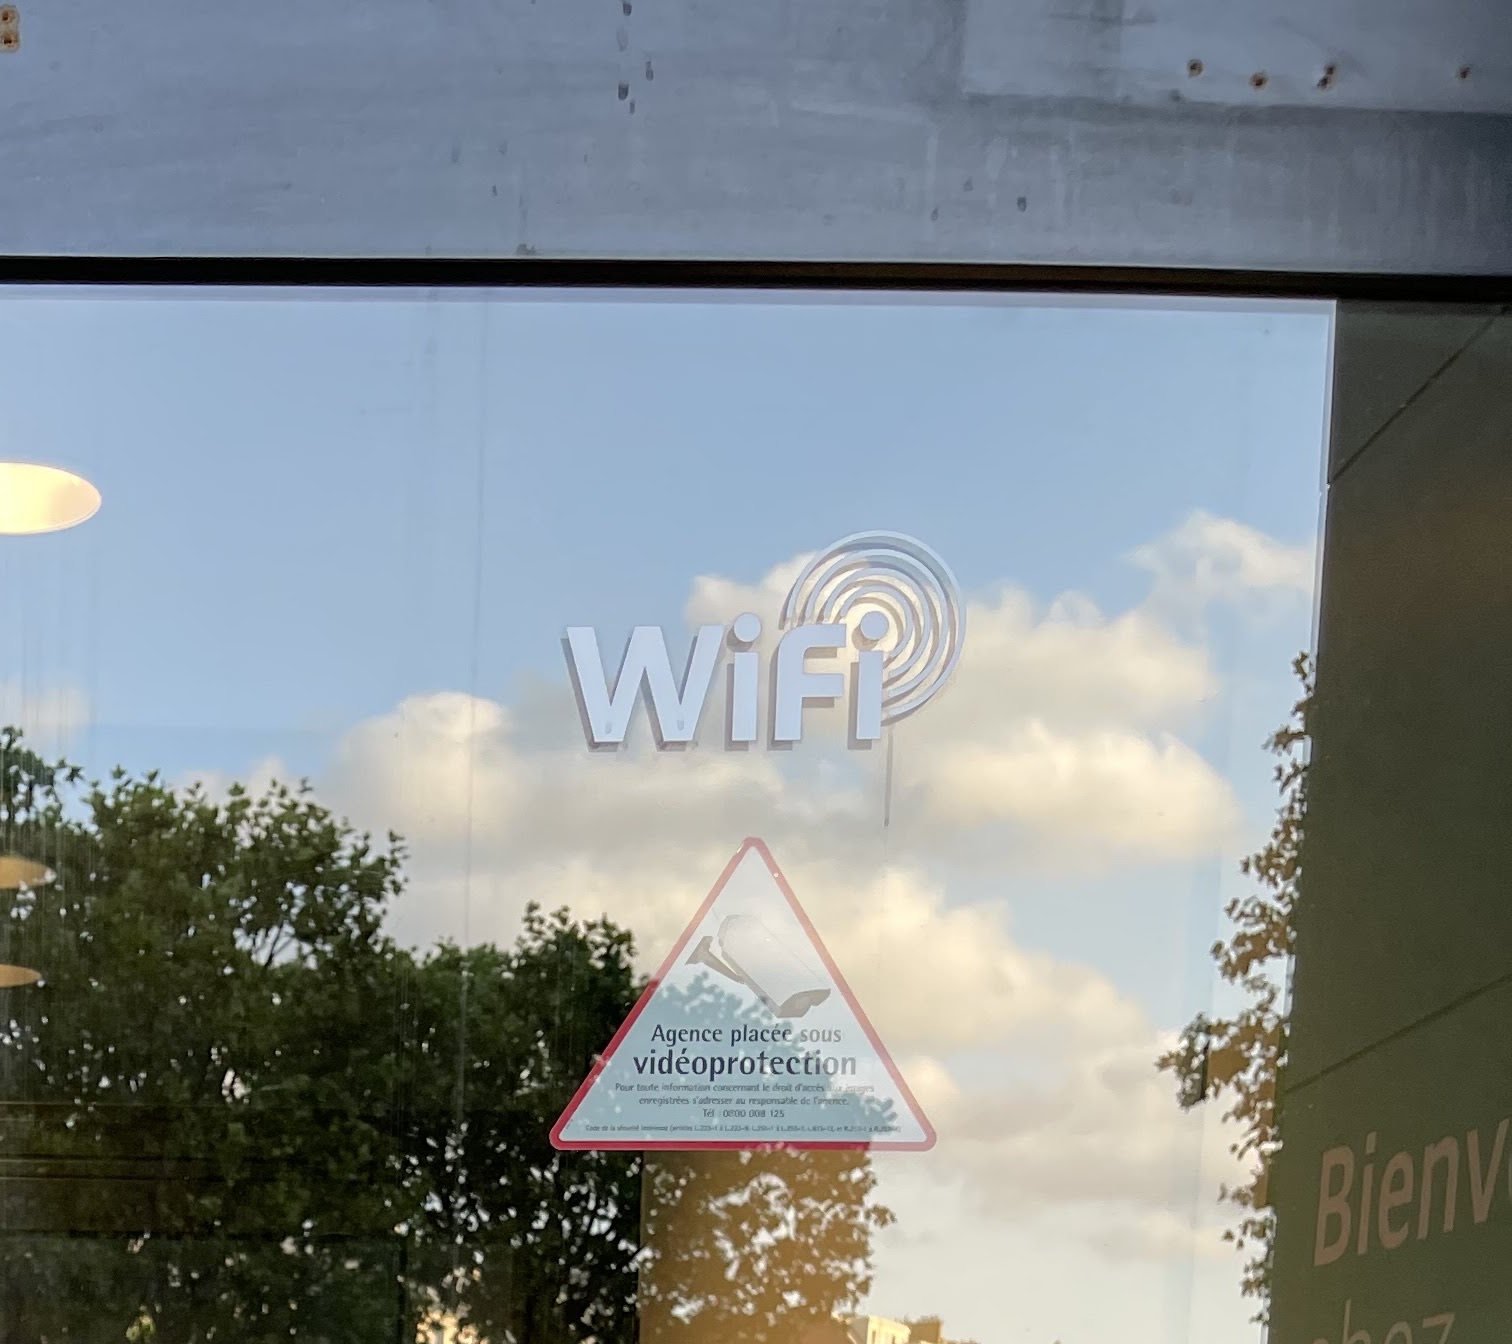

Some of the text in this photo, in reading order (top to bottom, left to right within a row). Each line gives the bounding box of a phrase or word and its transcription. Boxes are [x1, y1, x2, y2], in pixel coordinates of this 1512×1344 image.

[566, 611, 884, 743] WiFi
[633, 1048, 857, 1082] vidéoprotection
[651, 1023, 842, 1047] Agence placée sous
[1314, 1119, 1512, 1268] Bienv
